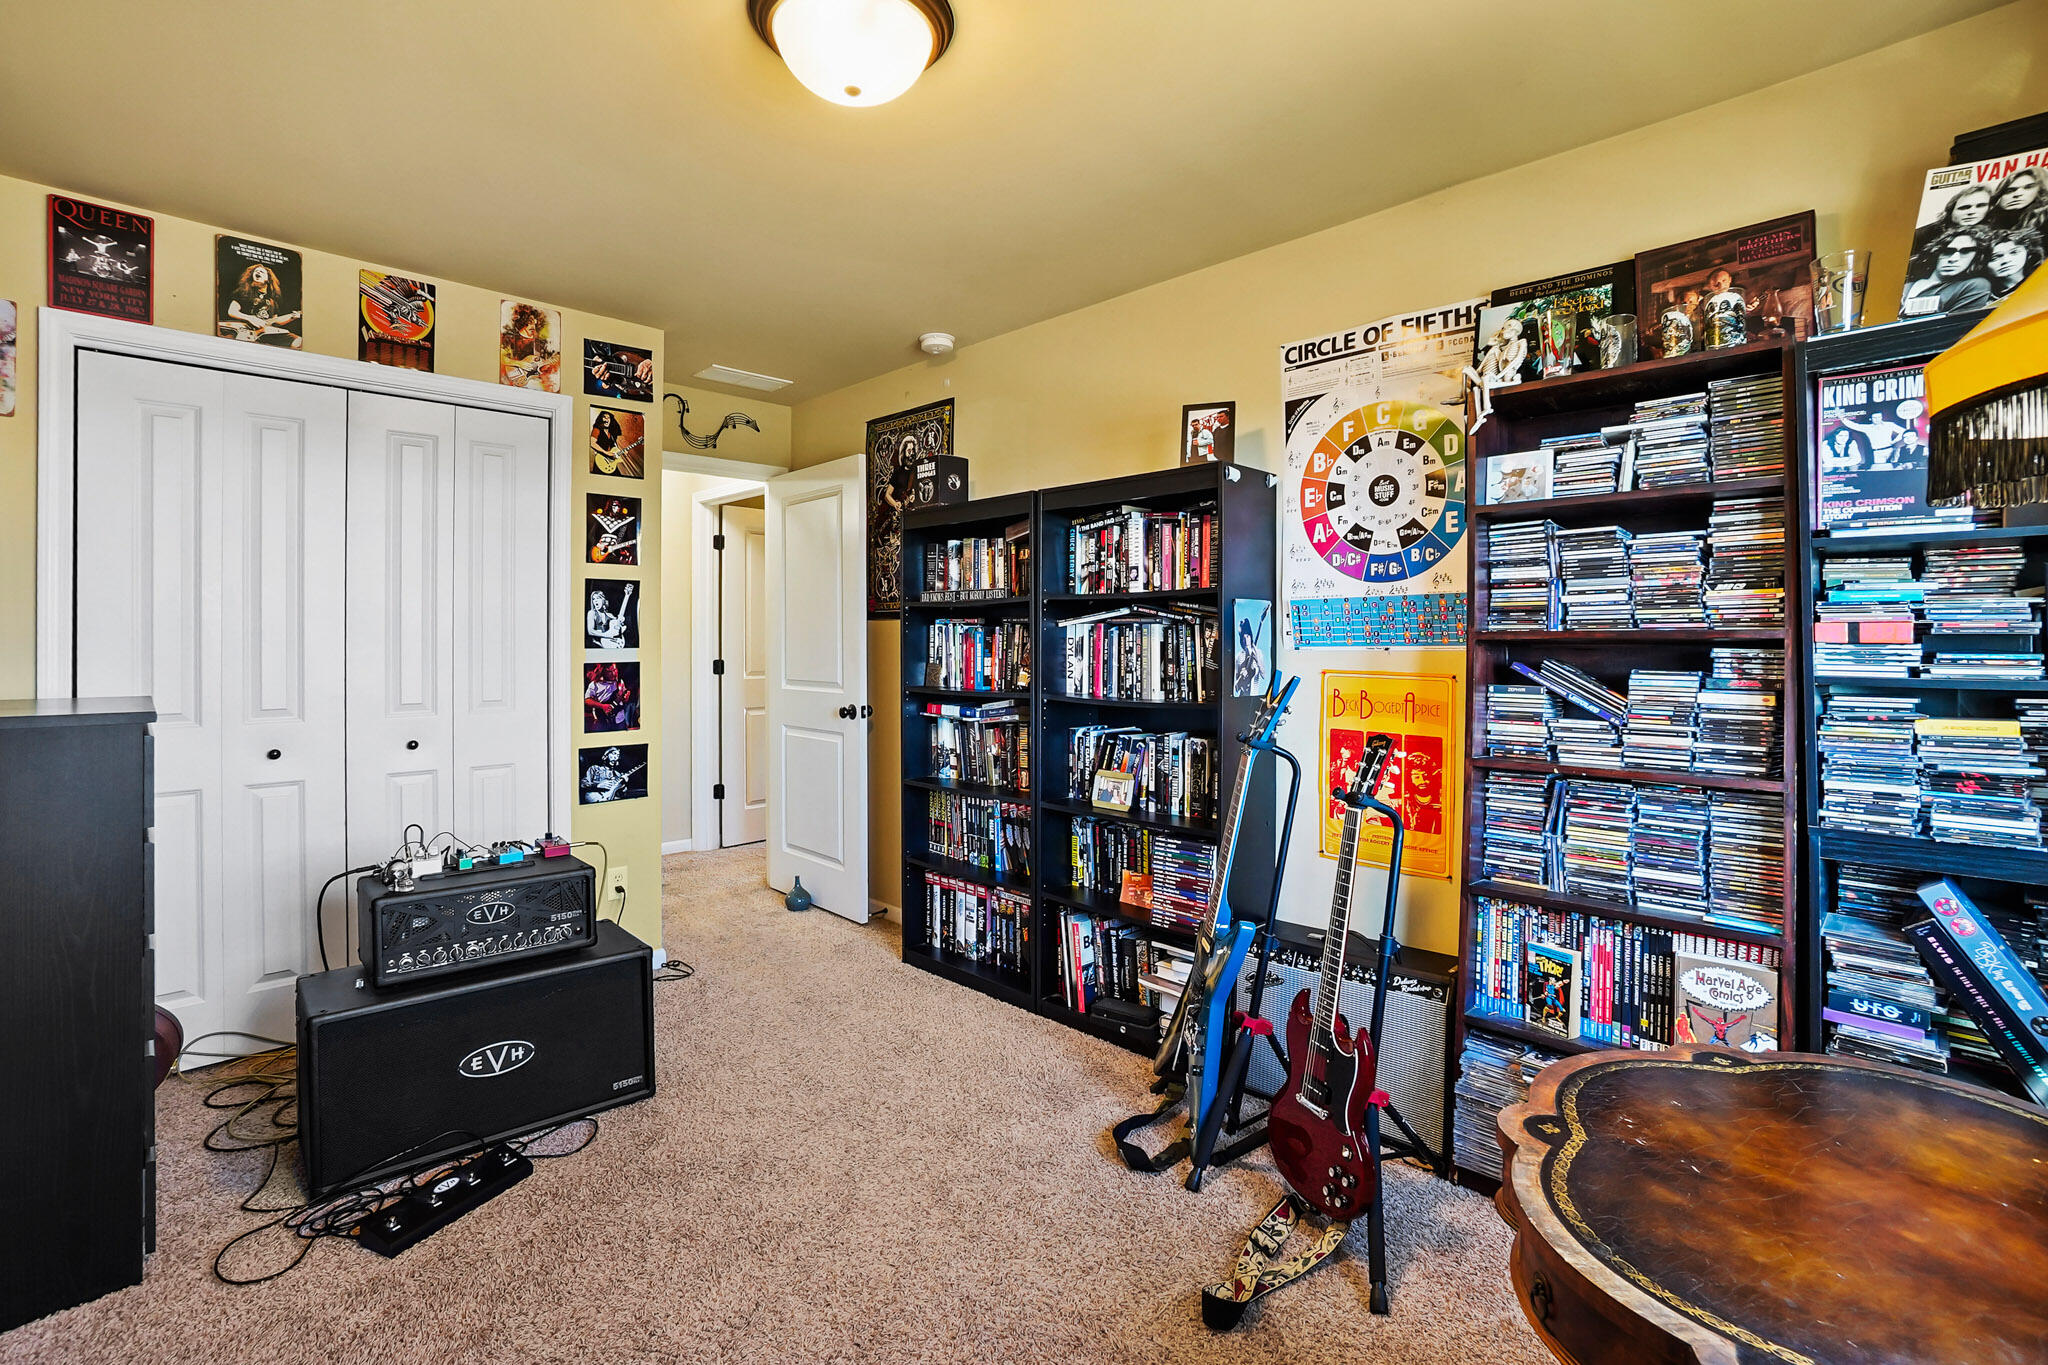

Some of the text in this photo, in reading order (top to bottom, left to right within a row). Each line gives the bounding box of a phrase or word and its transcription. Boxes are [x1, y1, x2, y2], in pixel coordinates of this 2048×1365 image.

[1930, 169, 1972, 186] GUITAR
[1976, 158, 2019, 183] VAN
[54, 199, 148, 234] QUEEN
[1509, 287, 1533, 297] DEREK
[1536, 283, 1553, 291] AND
[1574, 269, 1614, 282] DOMINOS
[62, 285, 144, 306] NEW YORK CITY
[1284, 331, 1356, 365] CIRCLE
[1362, 322, 1394, 346] OF
[1851, 373, 1894, 383] ULTIMATE
[1824, 382, 1867, 408] KING
[1376, 403, 1390, 424] C
[1413, 410, 1428, 432] G
[1343, 420, 1354, 442] F
[1443, 434, 1458, 456] D
[916, 462, 936, 474] THREE
[1374, 484, 1394, 492] MUSIC
[1823, 496, 1915, 508] KING CRIMSON
[1445, 511, 1459, 534] E
[473, 904, 508, 922] EVH
[550, 912, 573, 922] 5150
[977, 906, 985, 931] VENOM
[1927, 936, 1954, 965] ELVIS
[1538, 958, 1564, 978] THOR!
[1393, 976, 1418, 986] Deluxe
[1695, 970, 1762, 1000] Marvel Age
[1708, 987, 1744, 1004] Comics
[1852, 999, 1901, 1018] UFO
[470, 1045, 526, 1072] EVH
[612, 1078, 634, 1091] 5150
[437, 1178, 458, 1192] EVH
